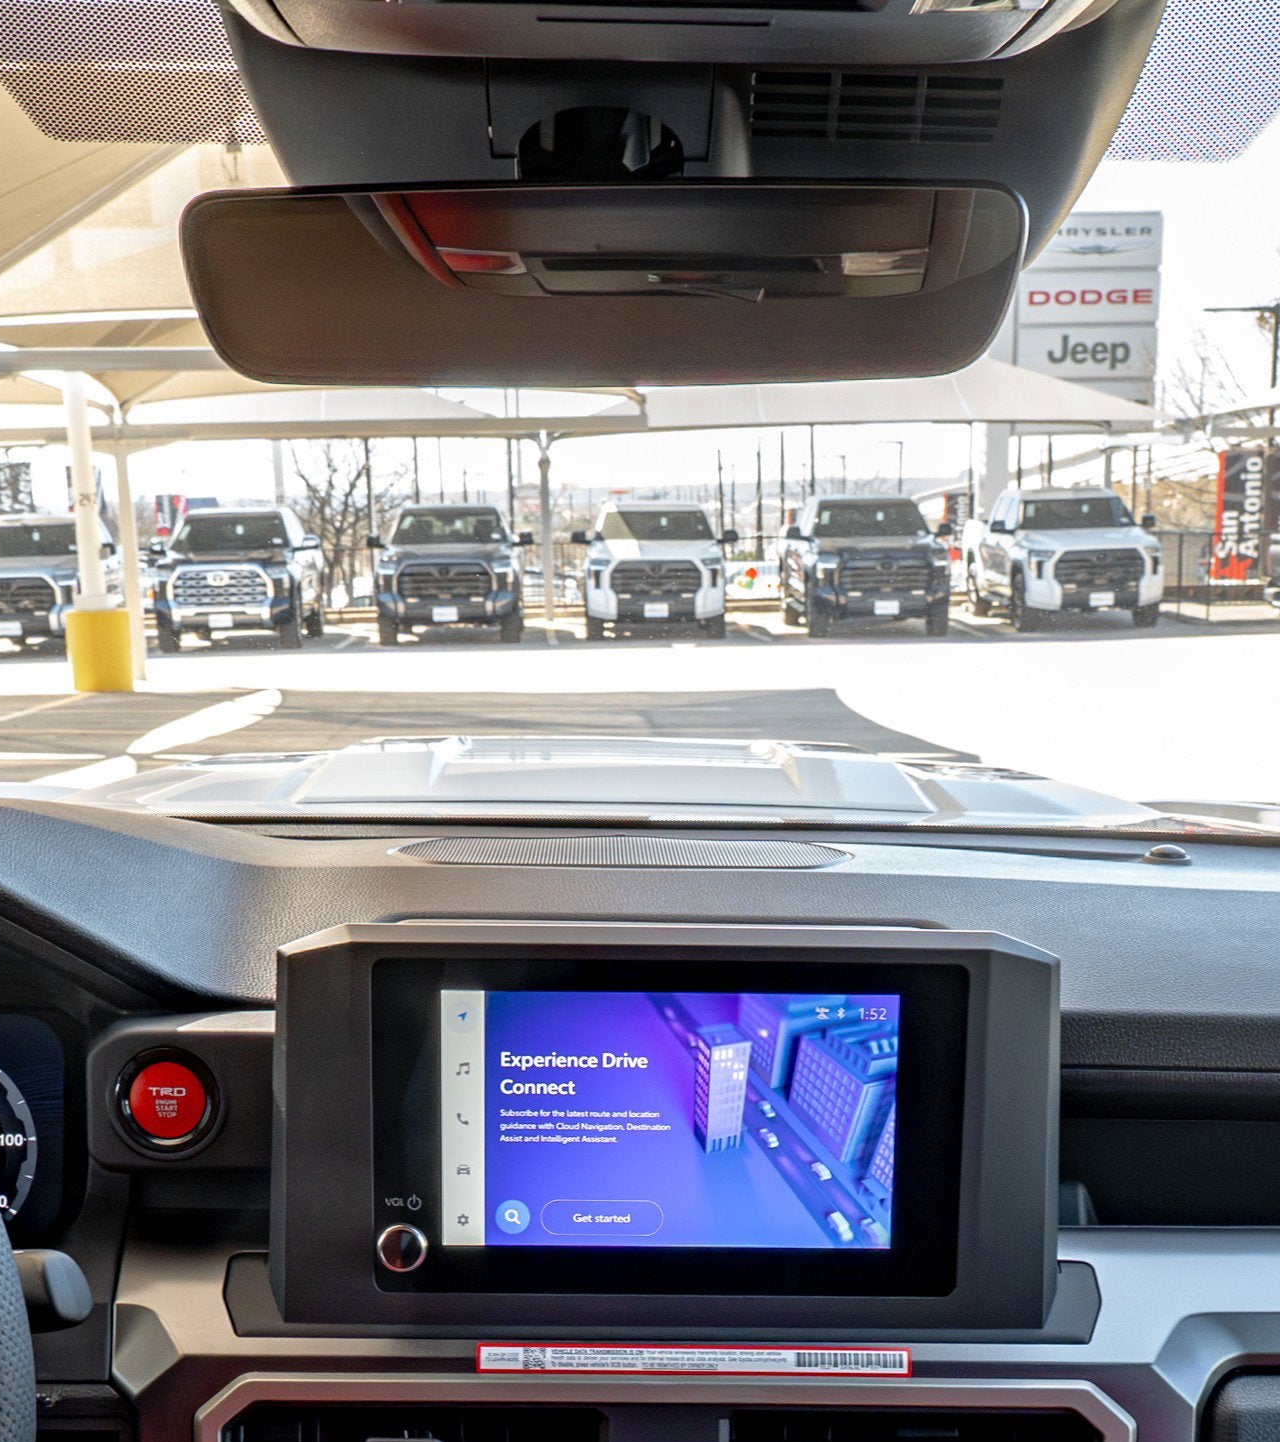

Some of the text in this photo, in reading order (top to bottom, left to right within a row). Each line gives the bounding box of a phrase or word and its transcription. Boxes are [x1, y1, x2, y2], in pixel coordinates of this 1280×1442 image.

[1027, 289, 1153, 306] DODGE
[1046, 333, 1131, 370] Jeep
[1238, 456, 1263, 559] Antonio
[1215, 510, 1240, 559] San
[858, 1007, 888, 1021] 1:52
[499, 1051, 649, 1071] Experience Drive
[148, 1086, 187, 1097] TRD
[499, 1078, 577, 1096] Connect
[499, 1109, 660, 1119] Subscribe for the latest route and location
[499, 1122, 537, 1131] guidance
[538, 1122, 555, 1131] with
[556, 1122, 580, 1131] Cloud
[626, 1123, 672, 1132] Destination
[499, 1134, 619, 1145] Assist and Intelligent Assistant.
[384, 1197, 405, 1207] VOL
[572, 1213, 631, 1223] Get started
